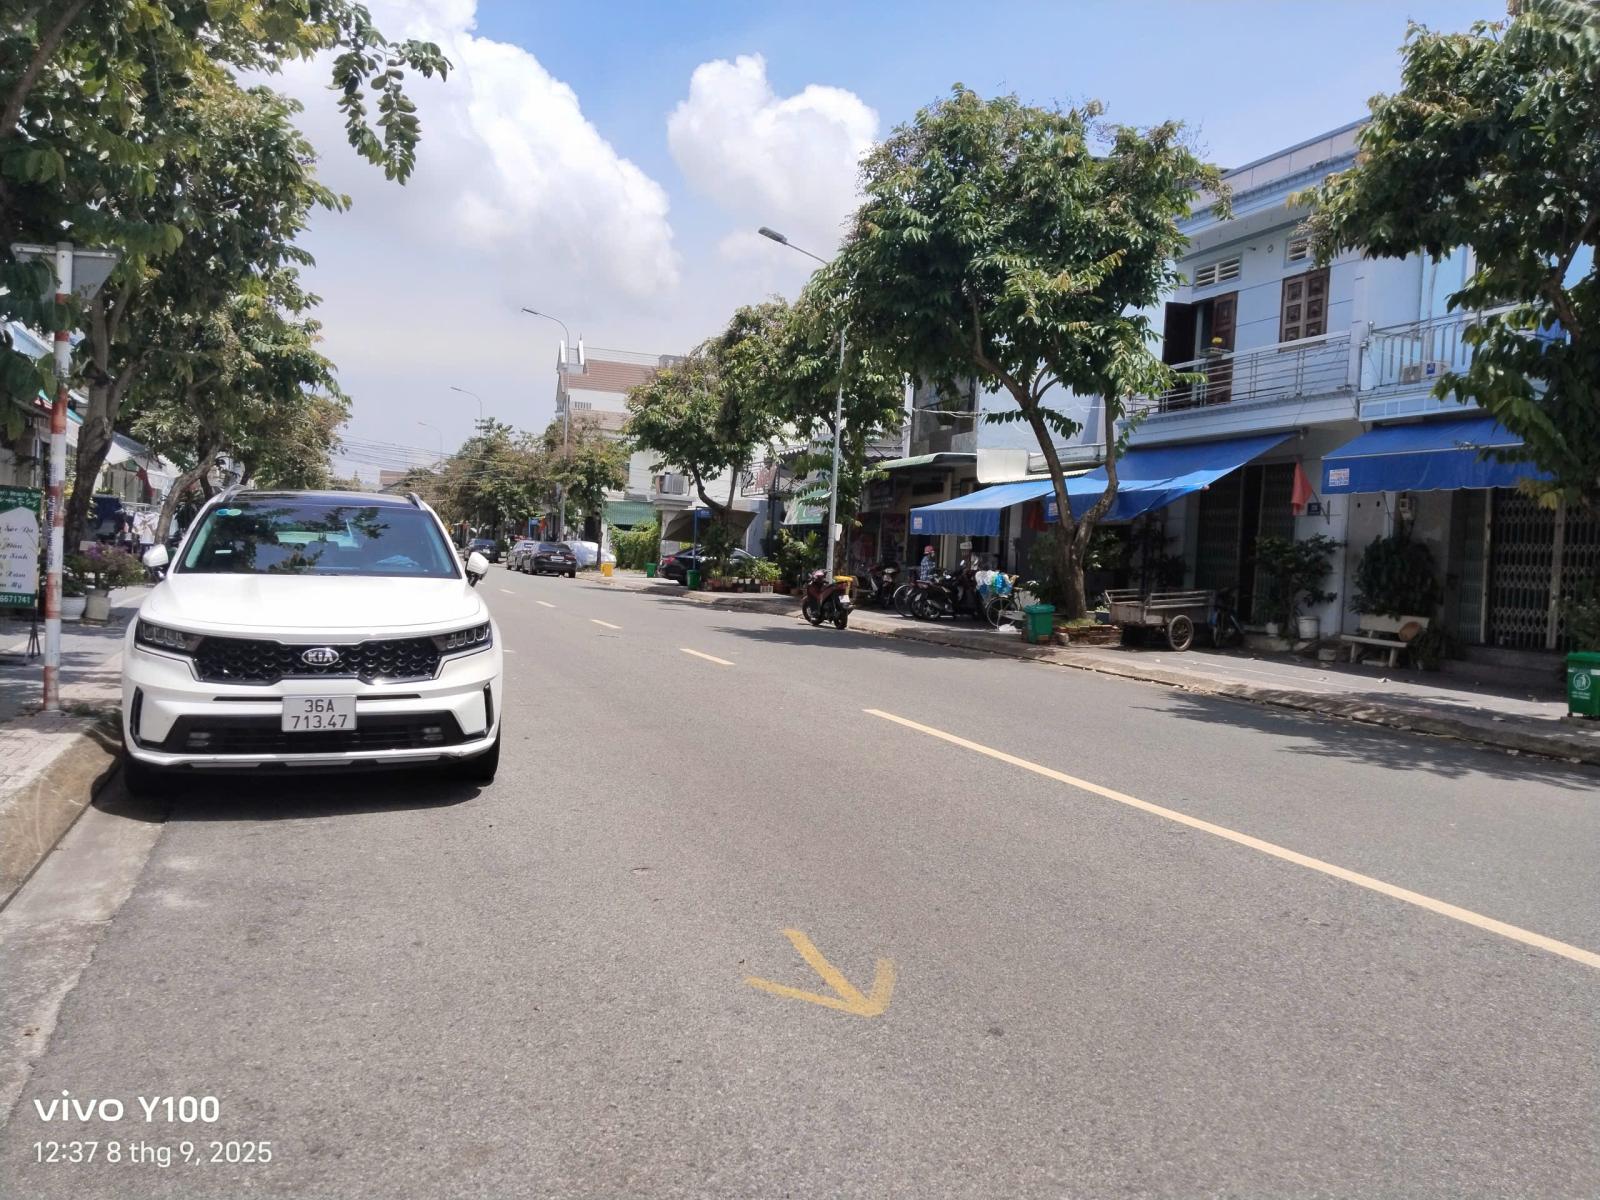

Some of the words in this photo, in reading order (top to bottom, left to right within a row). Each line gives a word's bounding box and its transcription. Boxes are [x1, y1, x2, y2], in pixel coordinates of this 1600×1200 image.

[308, 652, 333, 662] KIA
[305, 699, 335, 713] 36A
[291, 714, 347, 729] 713.47
